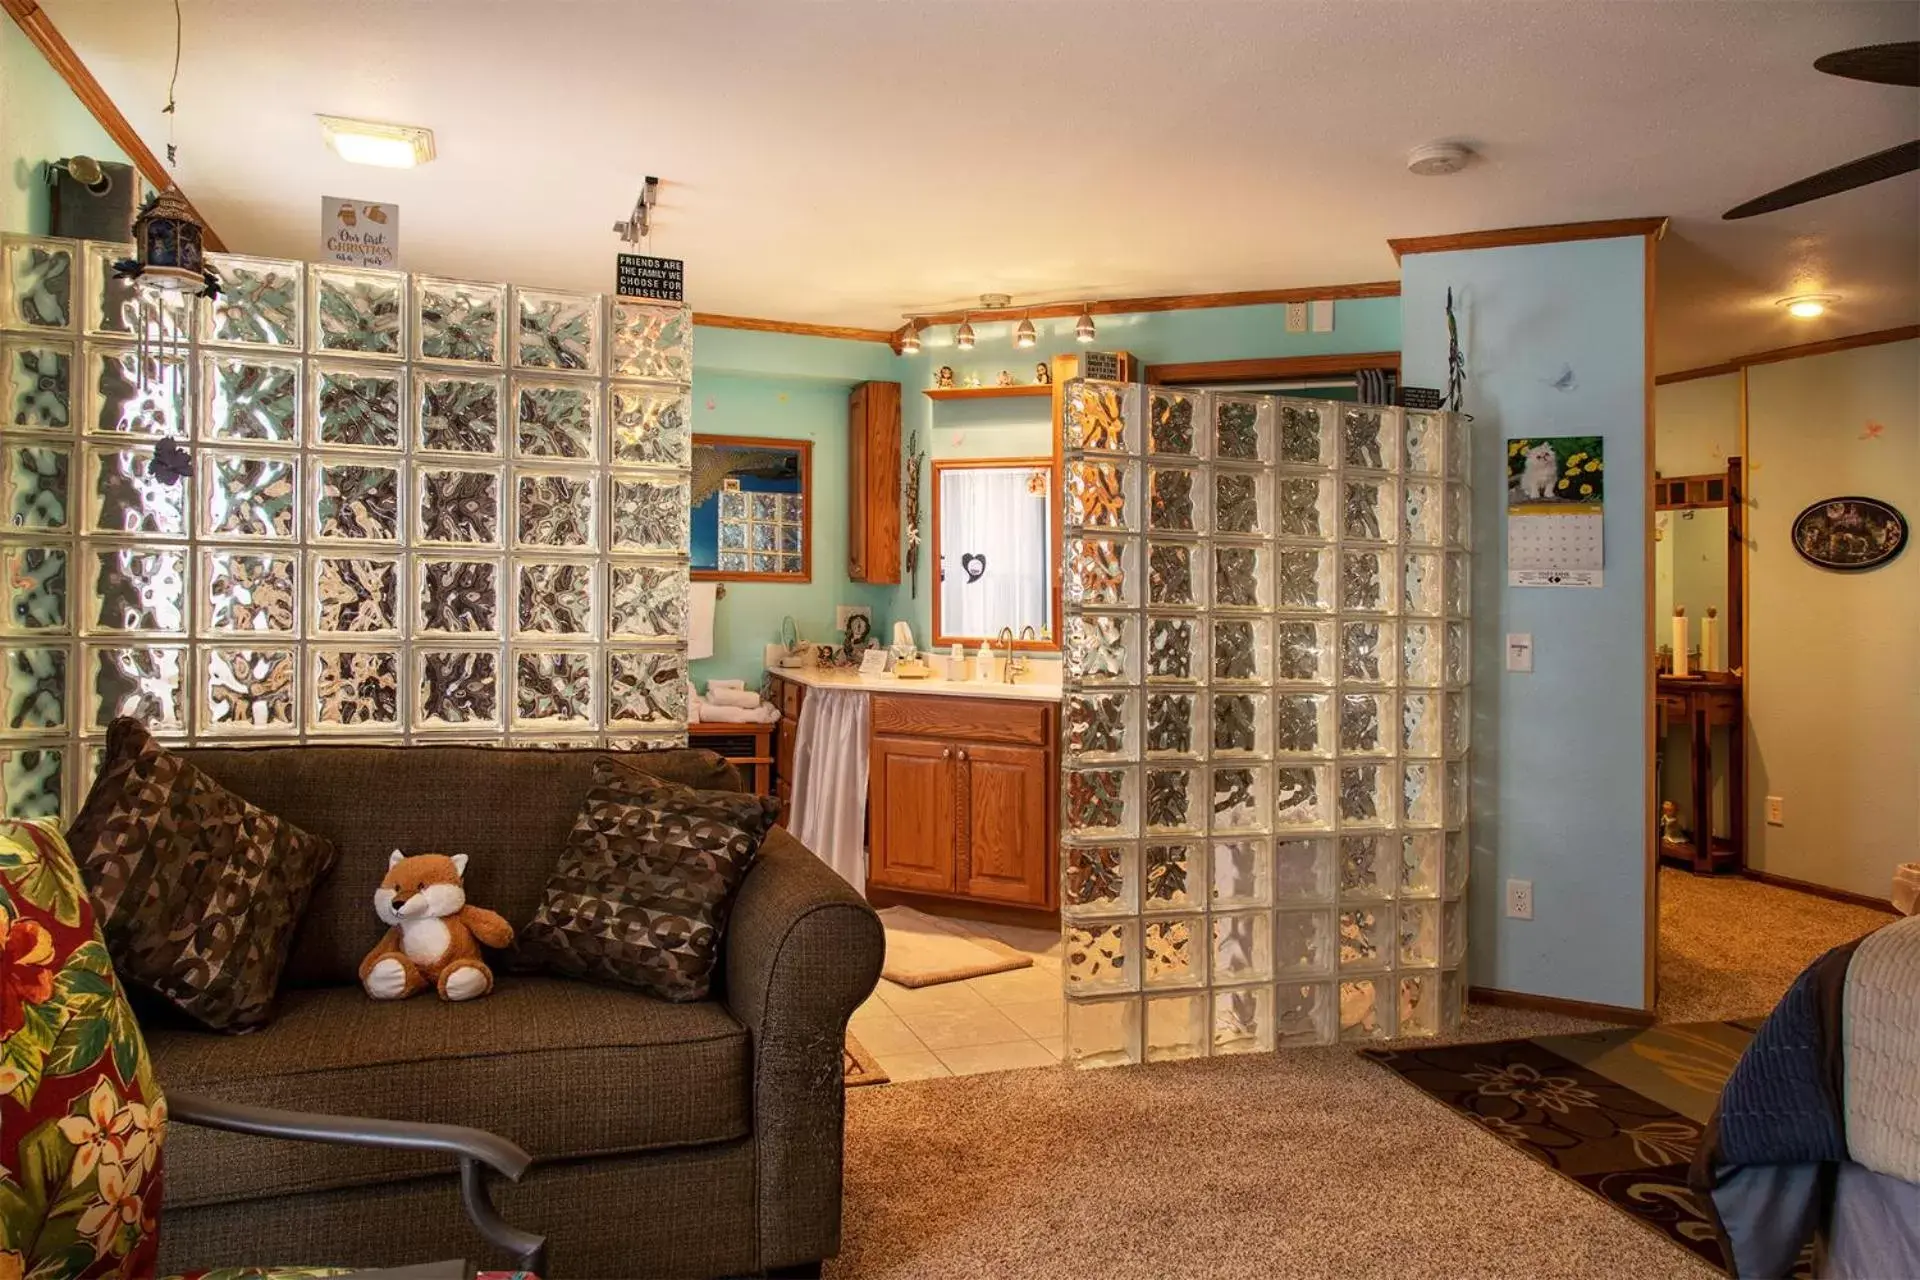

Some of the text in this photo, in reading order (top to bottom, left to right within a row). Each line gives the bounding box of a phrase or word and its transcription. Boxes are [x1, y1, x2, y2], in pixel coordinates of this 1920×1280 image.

[340, 229, 383, 244] Our first
[620, 257, 682, 270] FRIENDS ARE
[620, 266, 681, 280] THE FAMILY WE
[620, 276, 681, 290] CHOOSE FOR
[620, 286, 682, 300] OURSELVES
